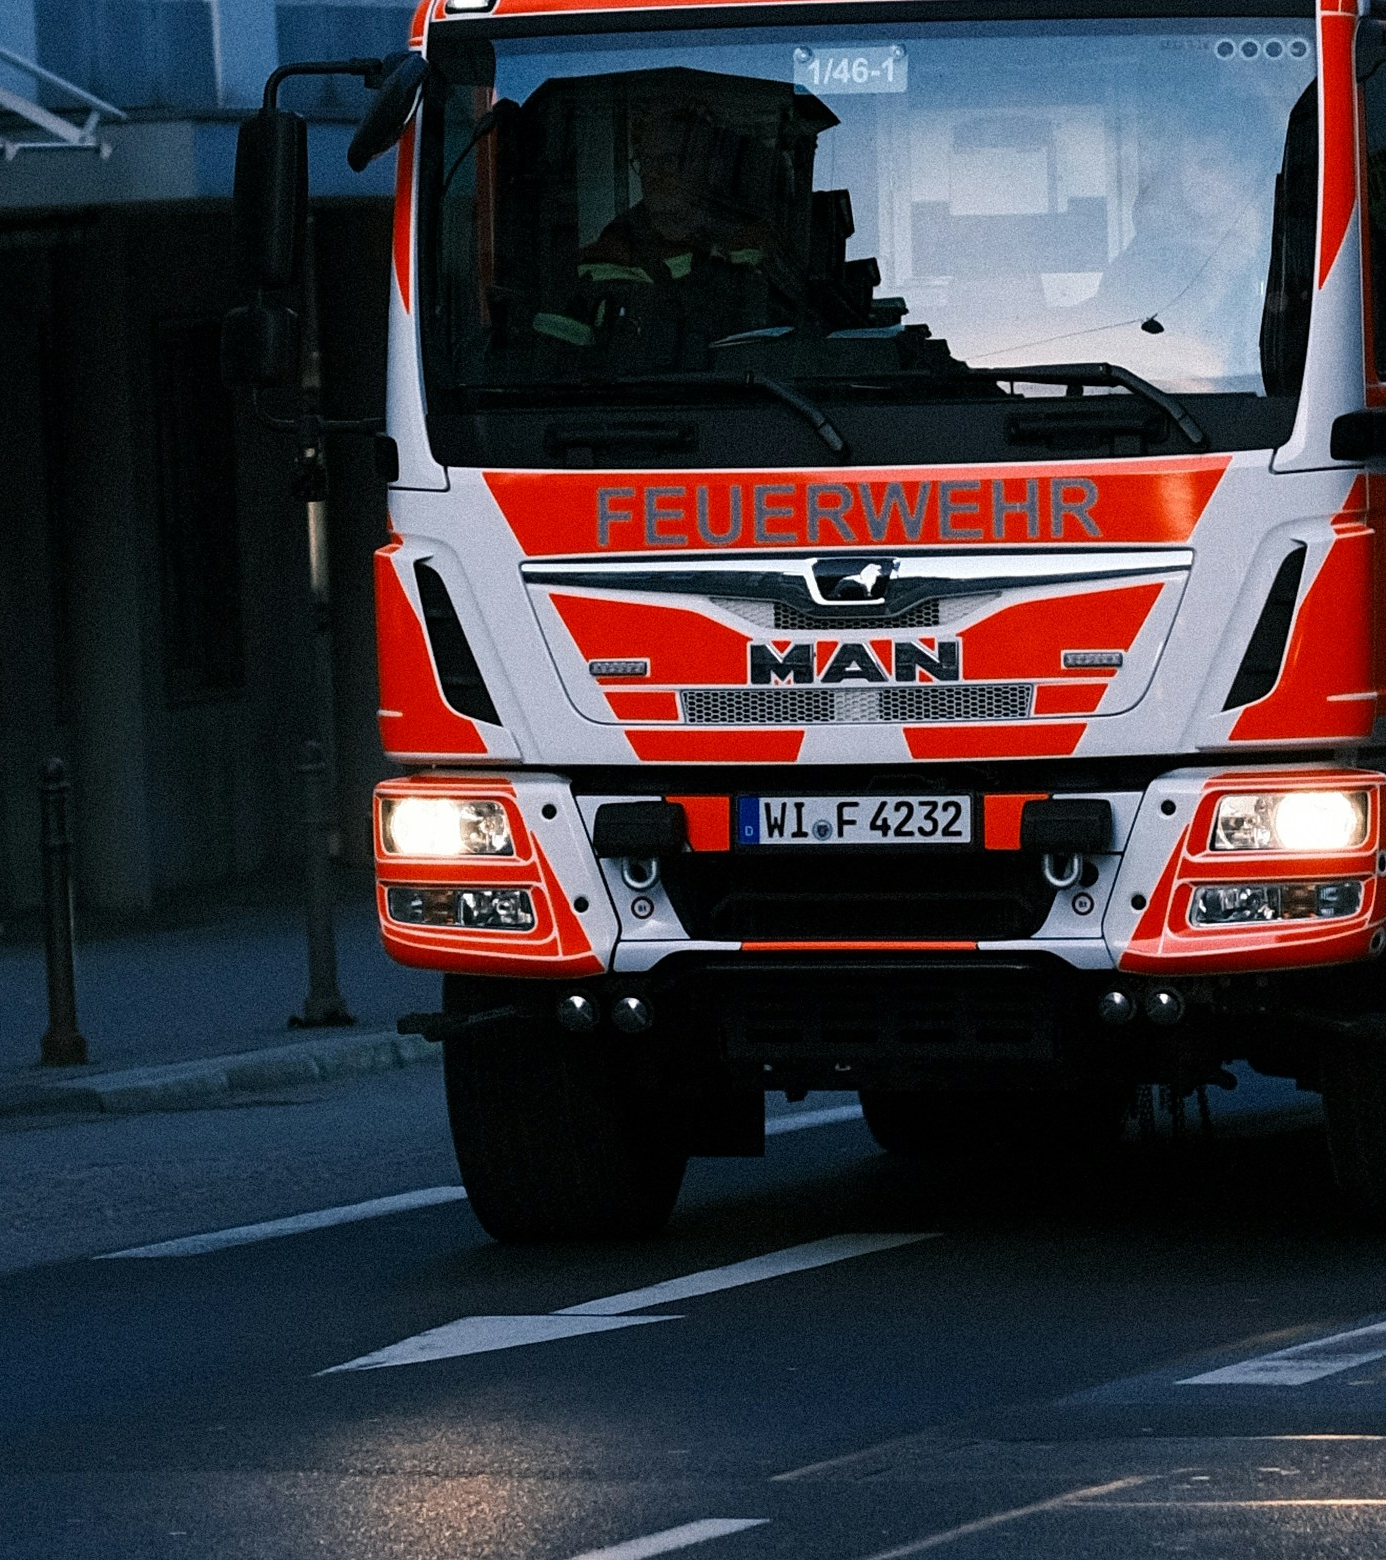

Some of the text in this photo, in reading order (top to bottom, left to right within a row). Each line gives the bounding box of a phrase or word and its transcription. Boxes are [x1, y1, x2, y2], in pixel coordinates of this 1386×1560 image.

[808, 57, 894, 85] 1/46-1
[596, 477, 1103, 546] FEUERWEHR
[749, 638, 962, 685] MAN
[744, 825, 754, 837] D
[764, 800, 963, 838] WI F 4232
